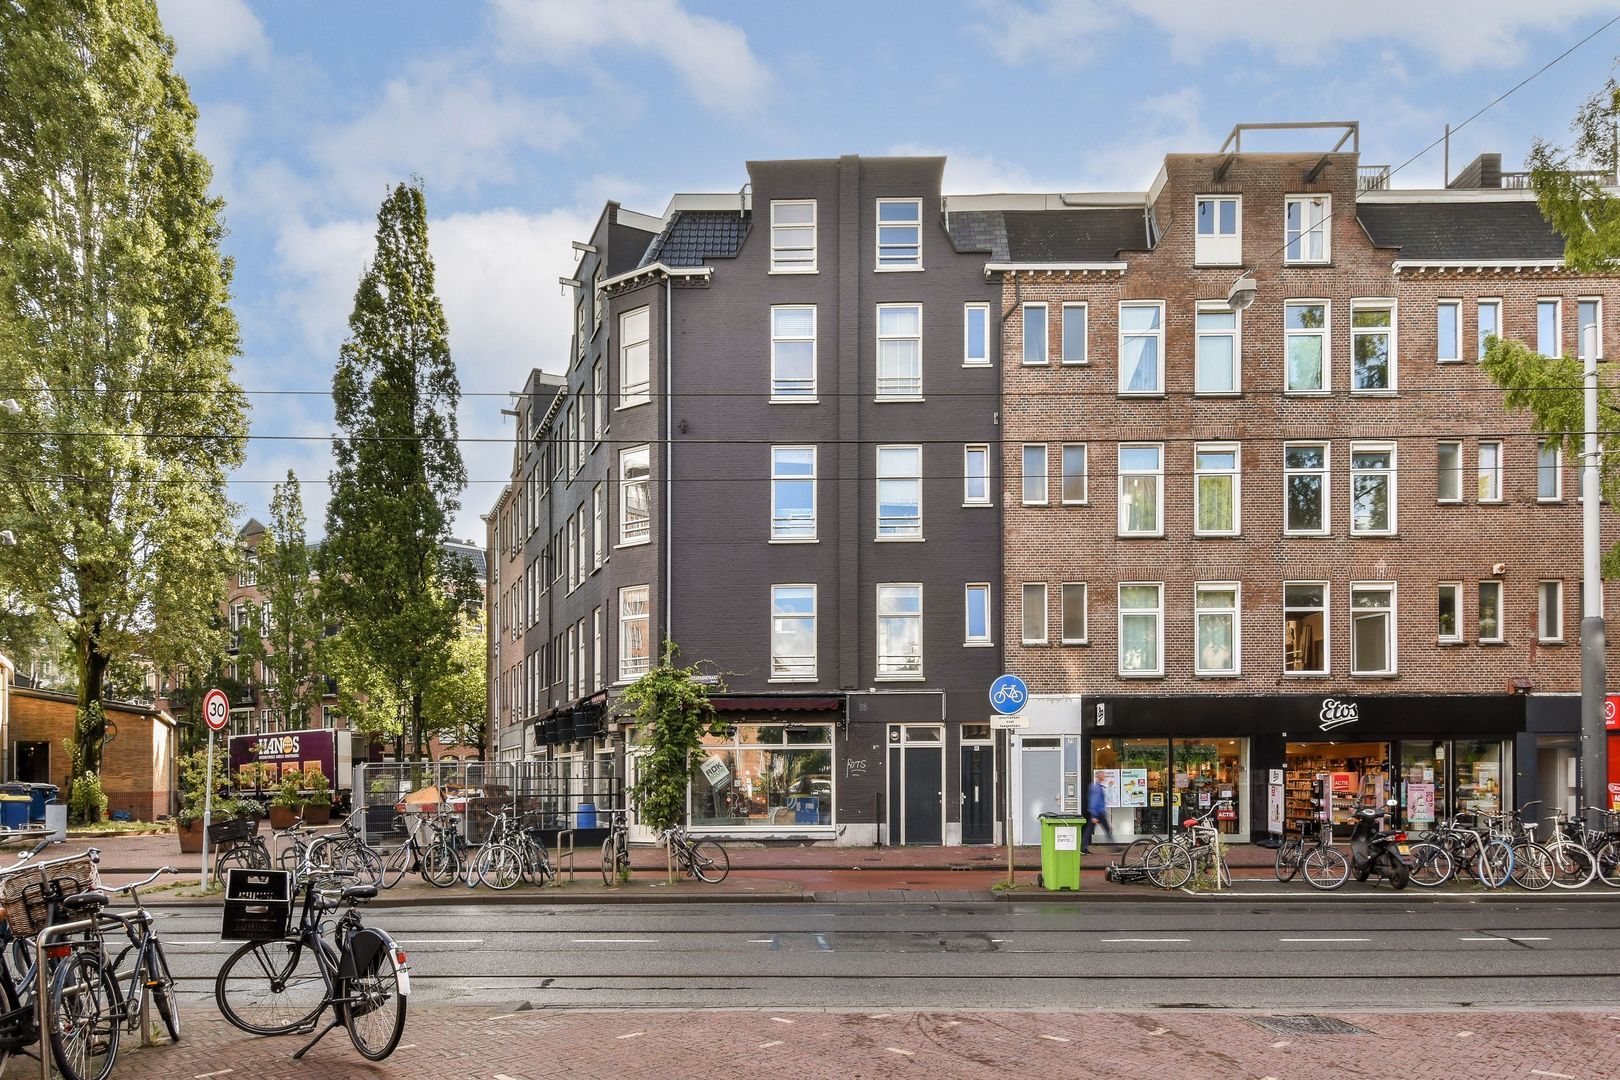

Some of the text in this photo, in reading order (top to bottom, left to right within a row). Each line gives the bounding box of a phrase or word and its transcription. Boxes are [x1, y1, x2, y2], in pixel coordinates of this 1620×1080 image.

[209, 702, 225, 717] 30
[1319, 698, 1359, 723] Etos
[258, 736, 300, 755] HANOS
